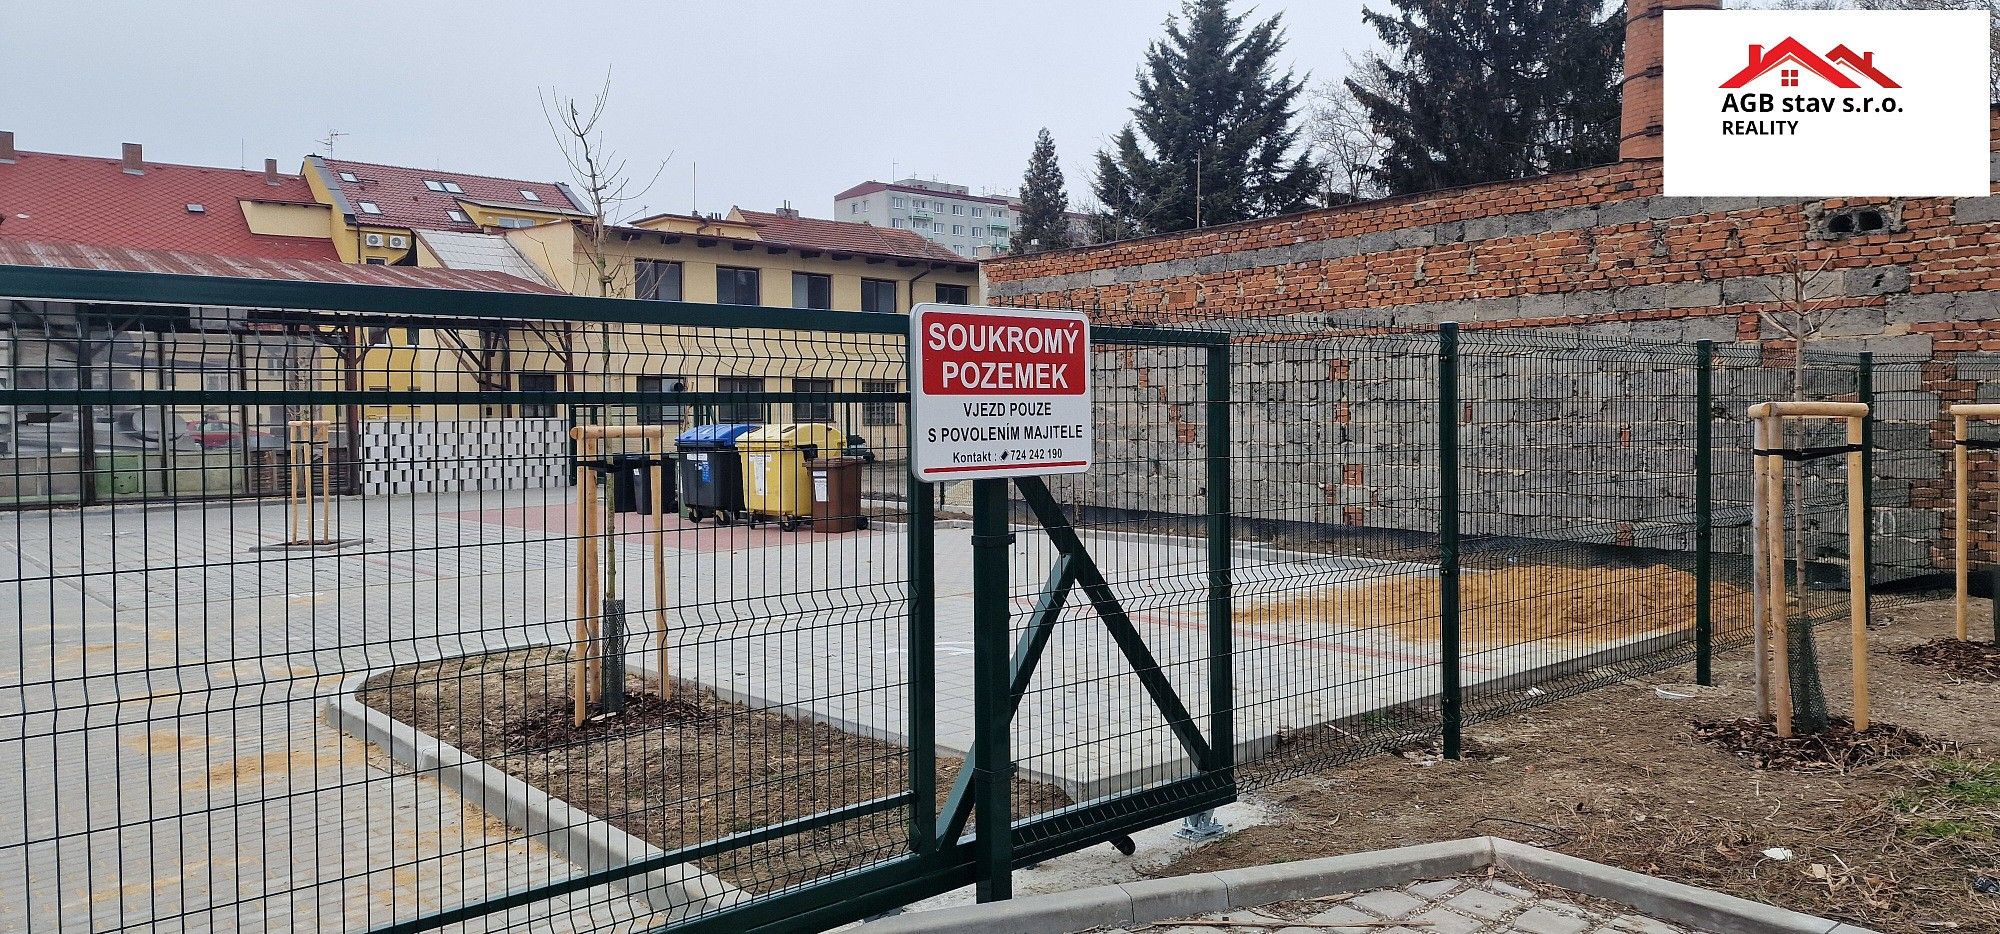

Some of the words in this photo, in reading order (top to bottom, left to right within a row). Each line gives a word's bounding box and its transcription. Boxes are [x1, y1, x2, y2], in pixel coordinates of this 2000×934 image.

[929, 322, 1079, 354] SOUKROMÝ
[942, 361, 1068, 389] POZEMEK
[963, 402, 1006, 417] VJEZD
[1009, 402, 1052, 416] POUZE
[928, 429, 937, 443] S
[941, 423, 1020, 442] POVOLENÍM
[1024, 425, 1083, 439] MAJITELE
[953, 451, 991, 464] Kontakt
[1010, 449, 1027, 461] 724
[1029, 449, 1045, 460] 242
[1047, 448, 1063, 459] 190
